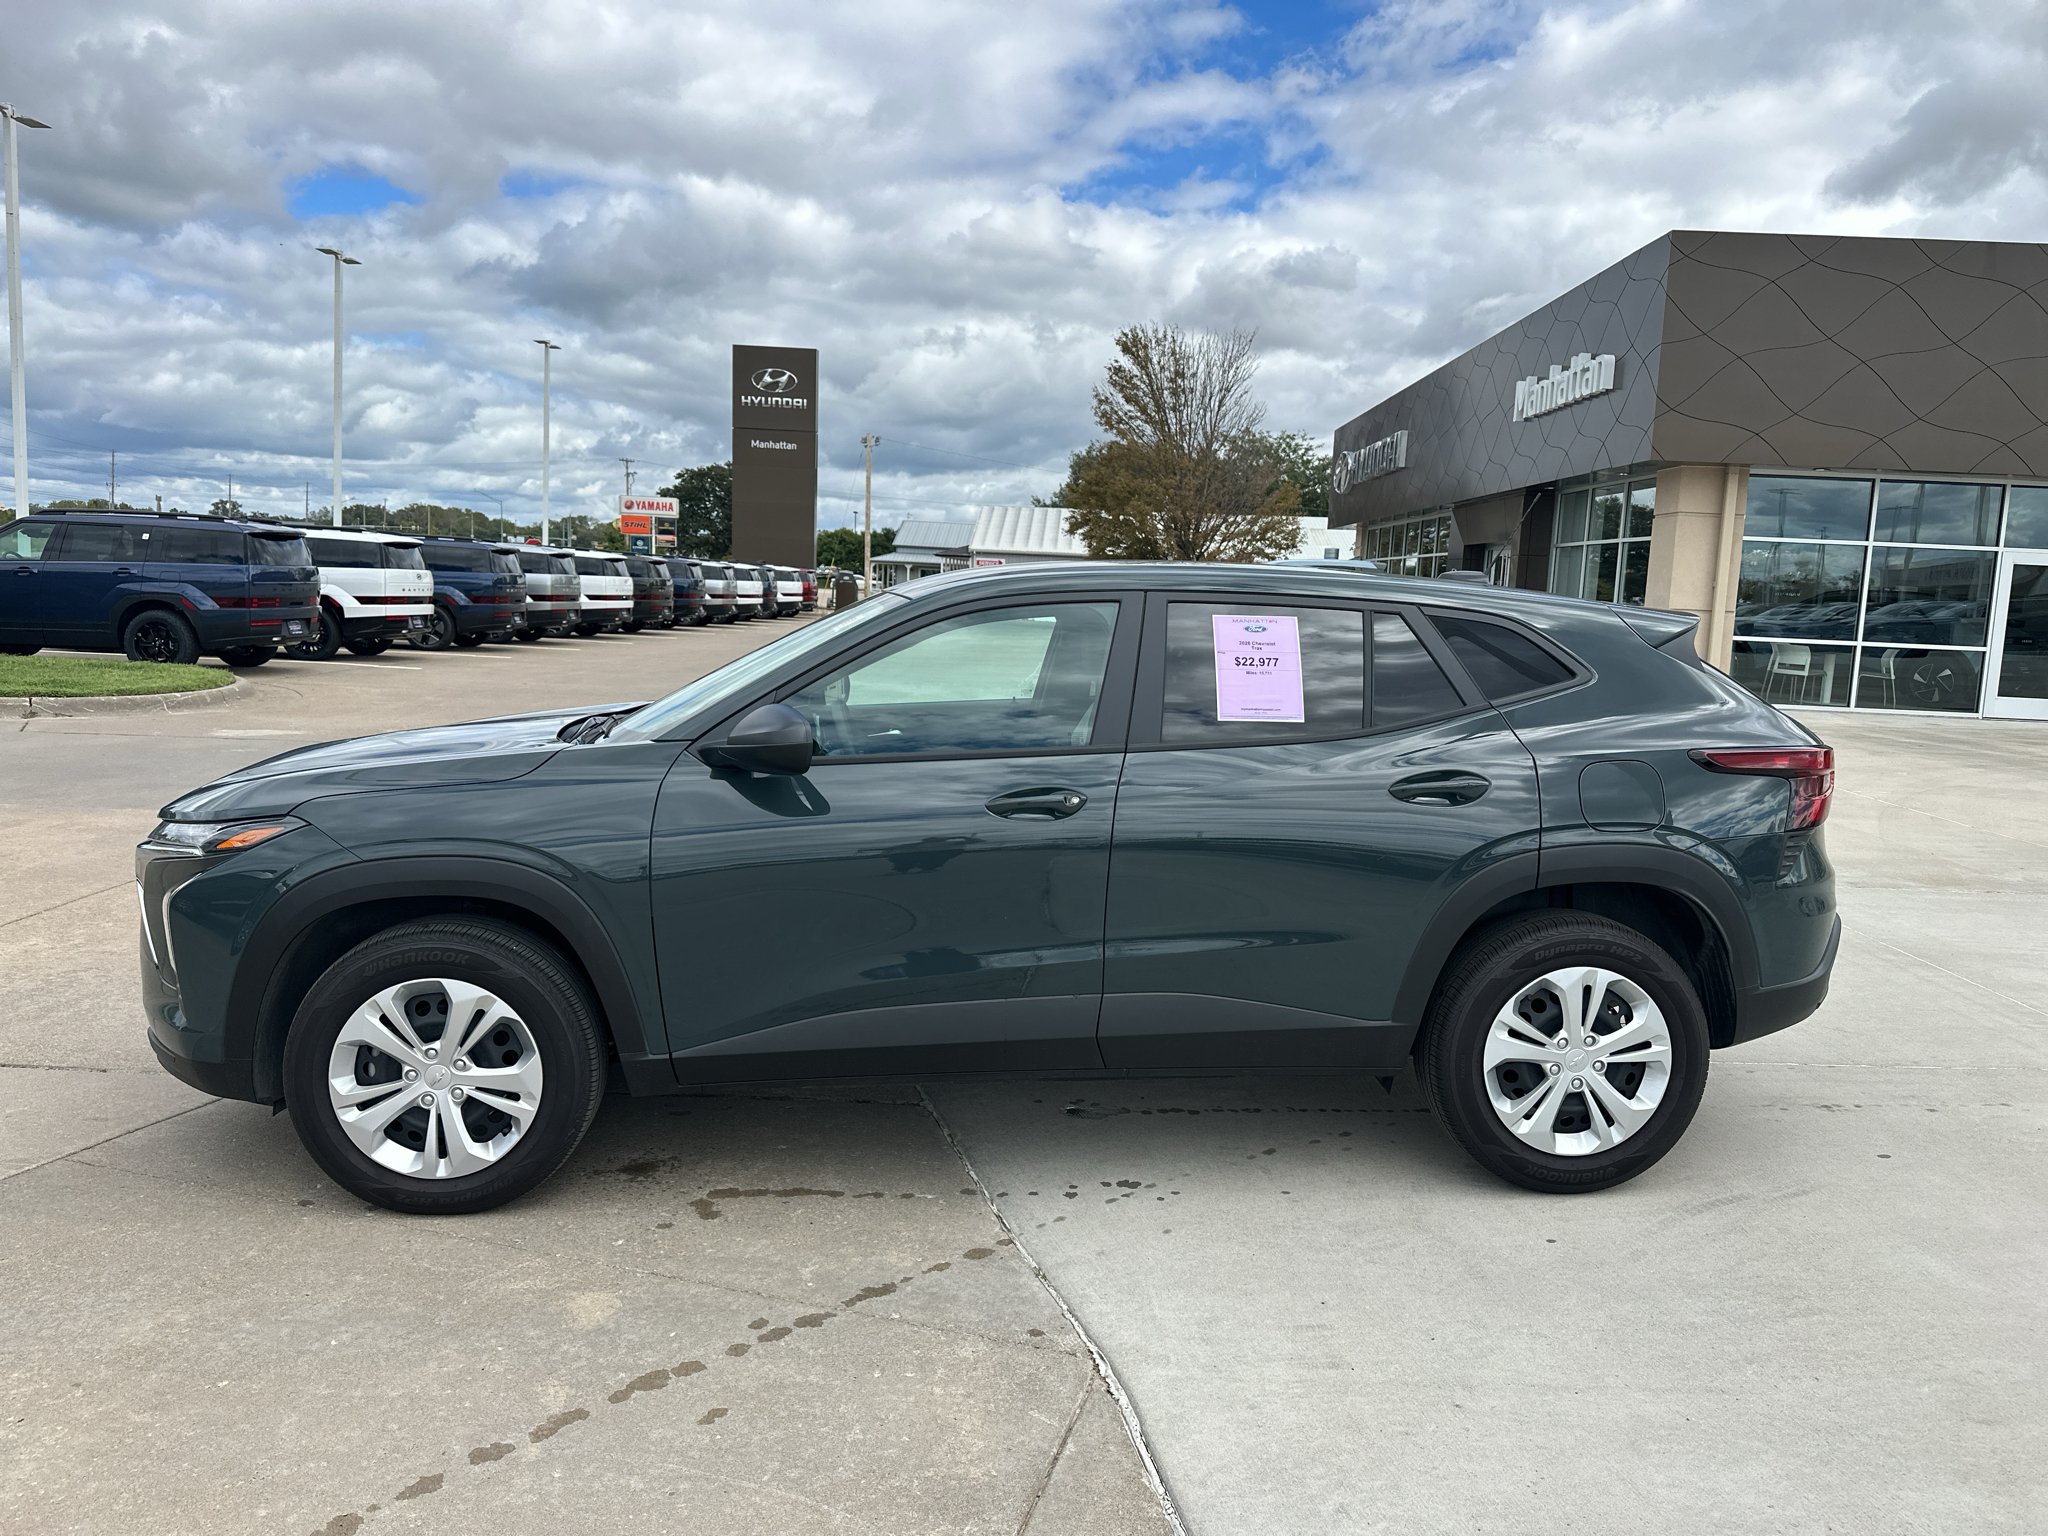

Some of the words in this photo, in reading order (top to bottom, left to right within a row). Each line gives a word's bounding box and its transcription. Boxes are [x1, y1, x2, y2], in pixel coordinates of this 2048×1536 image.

[1513, 352, 1616, 422] Manhattan
[741, 395, 808, 409] HYUNDAI
[751, 440, 797, 450] Manhattan
[635, 500, 674, 512] YAMAHA
[623, 521, 648, 529] STIHL
[1234, 656, 1279, 668] $22,977
